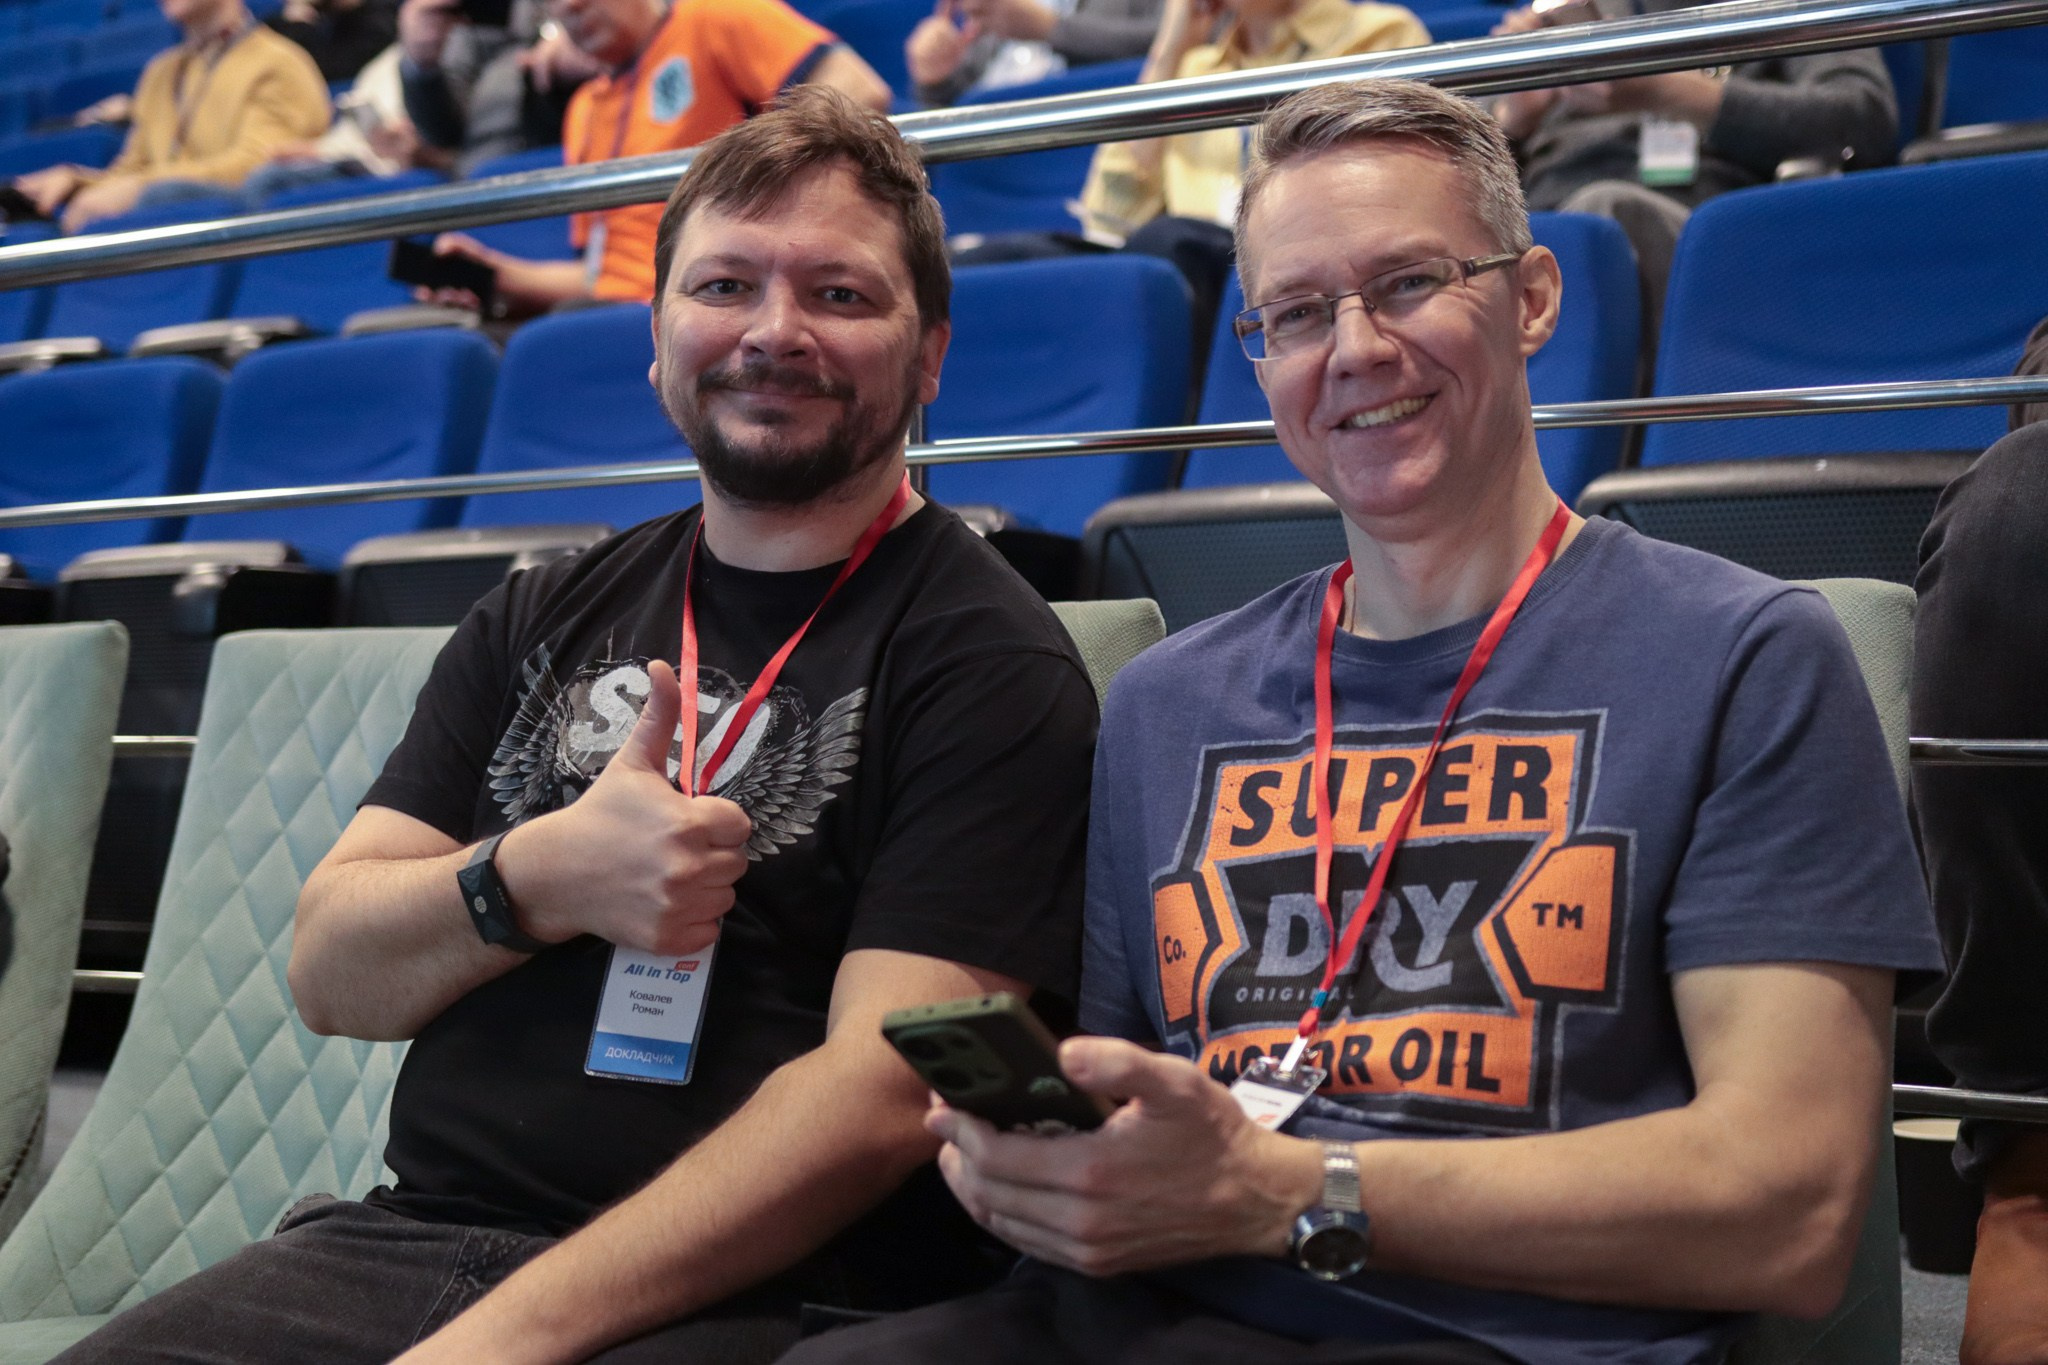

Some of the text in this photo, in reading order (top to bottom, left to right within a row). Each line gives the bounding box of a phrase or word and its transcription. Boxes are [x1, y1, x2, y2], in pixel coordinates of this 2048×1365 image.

[1229, 743, 1552, 847] SUPER
[1532, 904, 1583, 929] TM
[1255, 880, 1478, 992] DRY
[1163, 935, 1187, 964] Co.
[624, 963, 691, 983] All in Top
[629, 989, 673, 1004] Ковалев
[632, 1003, 664, 1016] Роман
[604, 1046, 675, 1065] ДОКЛАДЧИК
[1390, 1028, 1500, 1092] OIL
